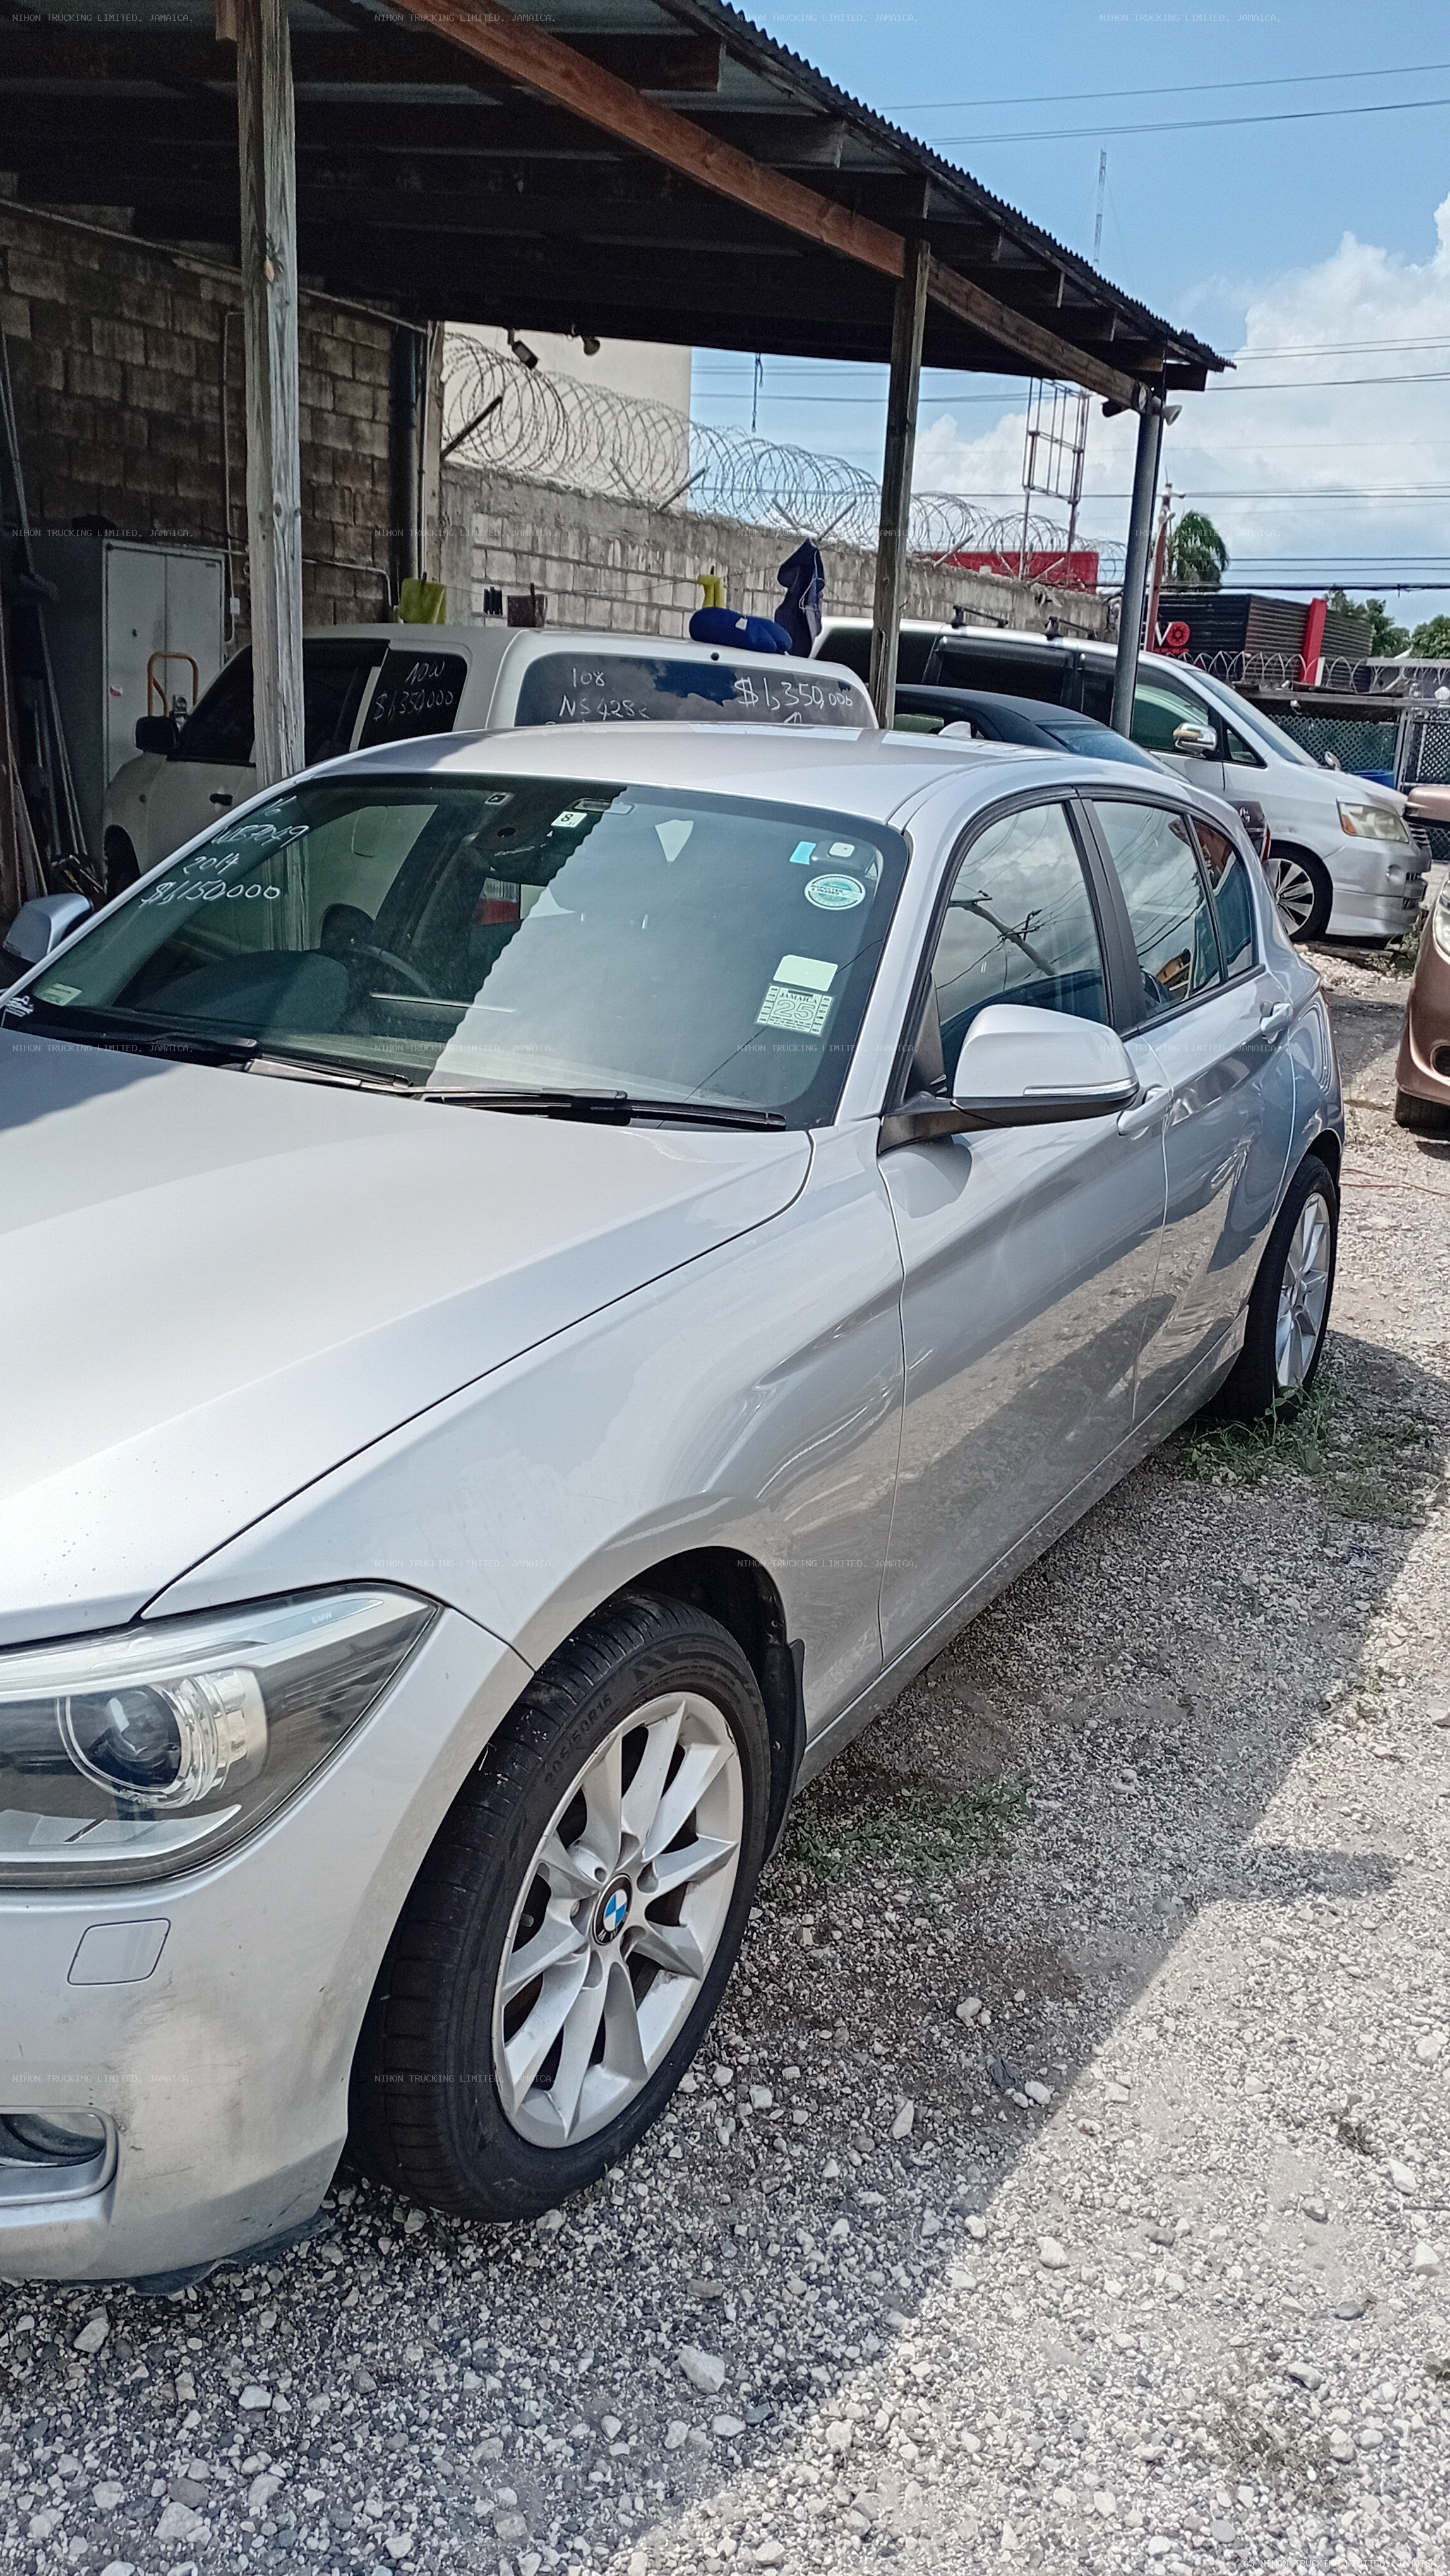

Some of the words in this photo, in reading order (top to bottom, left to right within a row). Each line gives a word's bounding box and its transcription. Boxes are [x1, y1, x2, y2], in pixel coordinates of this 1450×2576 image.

[572, 667, 605, 688] 108
[183, 852, 239, 874] 2014
[779, 993, 817, 1004] JAMAICA
[772, 999, 816, 1020] 25
